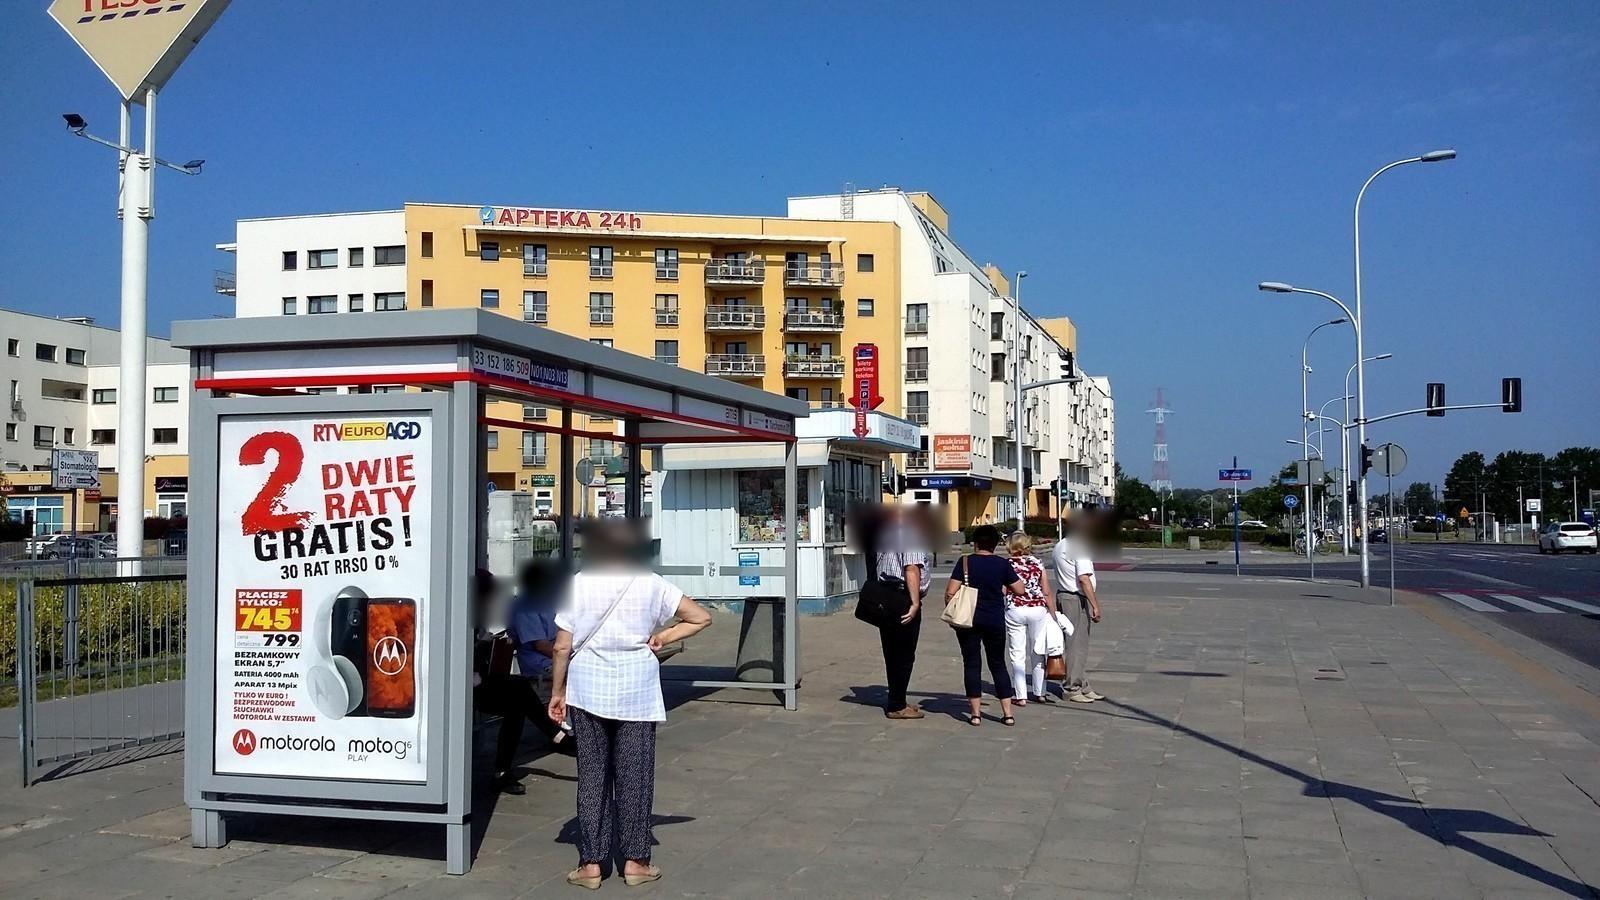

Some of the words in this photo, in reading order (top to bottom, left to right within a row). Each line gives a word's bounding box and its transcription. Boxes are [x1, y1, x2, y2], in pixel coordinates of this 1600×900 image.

[499, 209, 592, 228] APTEKA
[600, 212, 641, 229] 24h
[475, 350, 485, 366] 33
[487, 354, 500, 370] 152
[502, 357, 515, 373] 186
[516, 360, 530, 376] 509
[530, 364, 543, 379] N01
[556, 368, 568, 385] N13
[313, 423, 344, 441] RTV
[344, 424, 385, 437] EURO
[386, 422, 421, 440] AGD
[60, 461, 97, 472] Stomatologia
[322, 455, 415, 490] DWIE
[60, 476, 72, 484] RTG
[239, 431, 317, 536] 2
[325, 485, 416, 520] RATY
[281, 565, 298, 580] 30
[304, 561, 330, 577] RAT
[335, 557, 368, 574] RRSO
[238, 591, 288, 599] PŁACISZ
[240, 608, 292, 630] 745
[260, 734, 335, 751] motorola
[348, 754, 368, 762] PLAY
